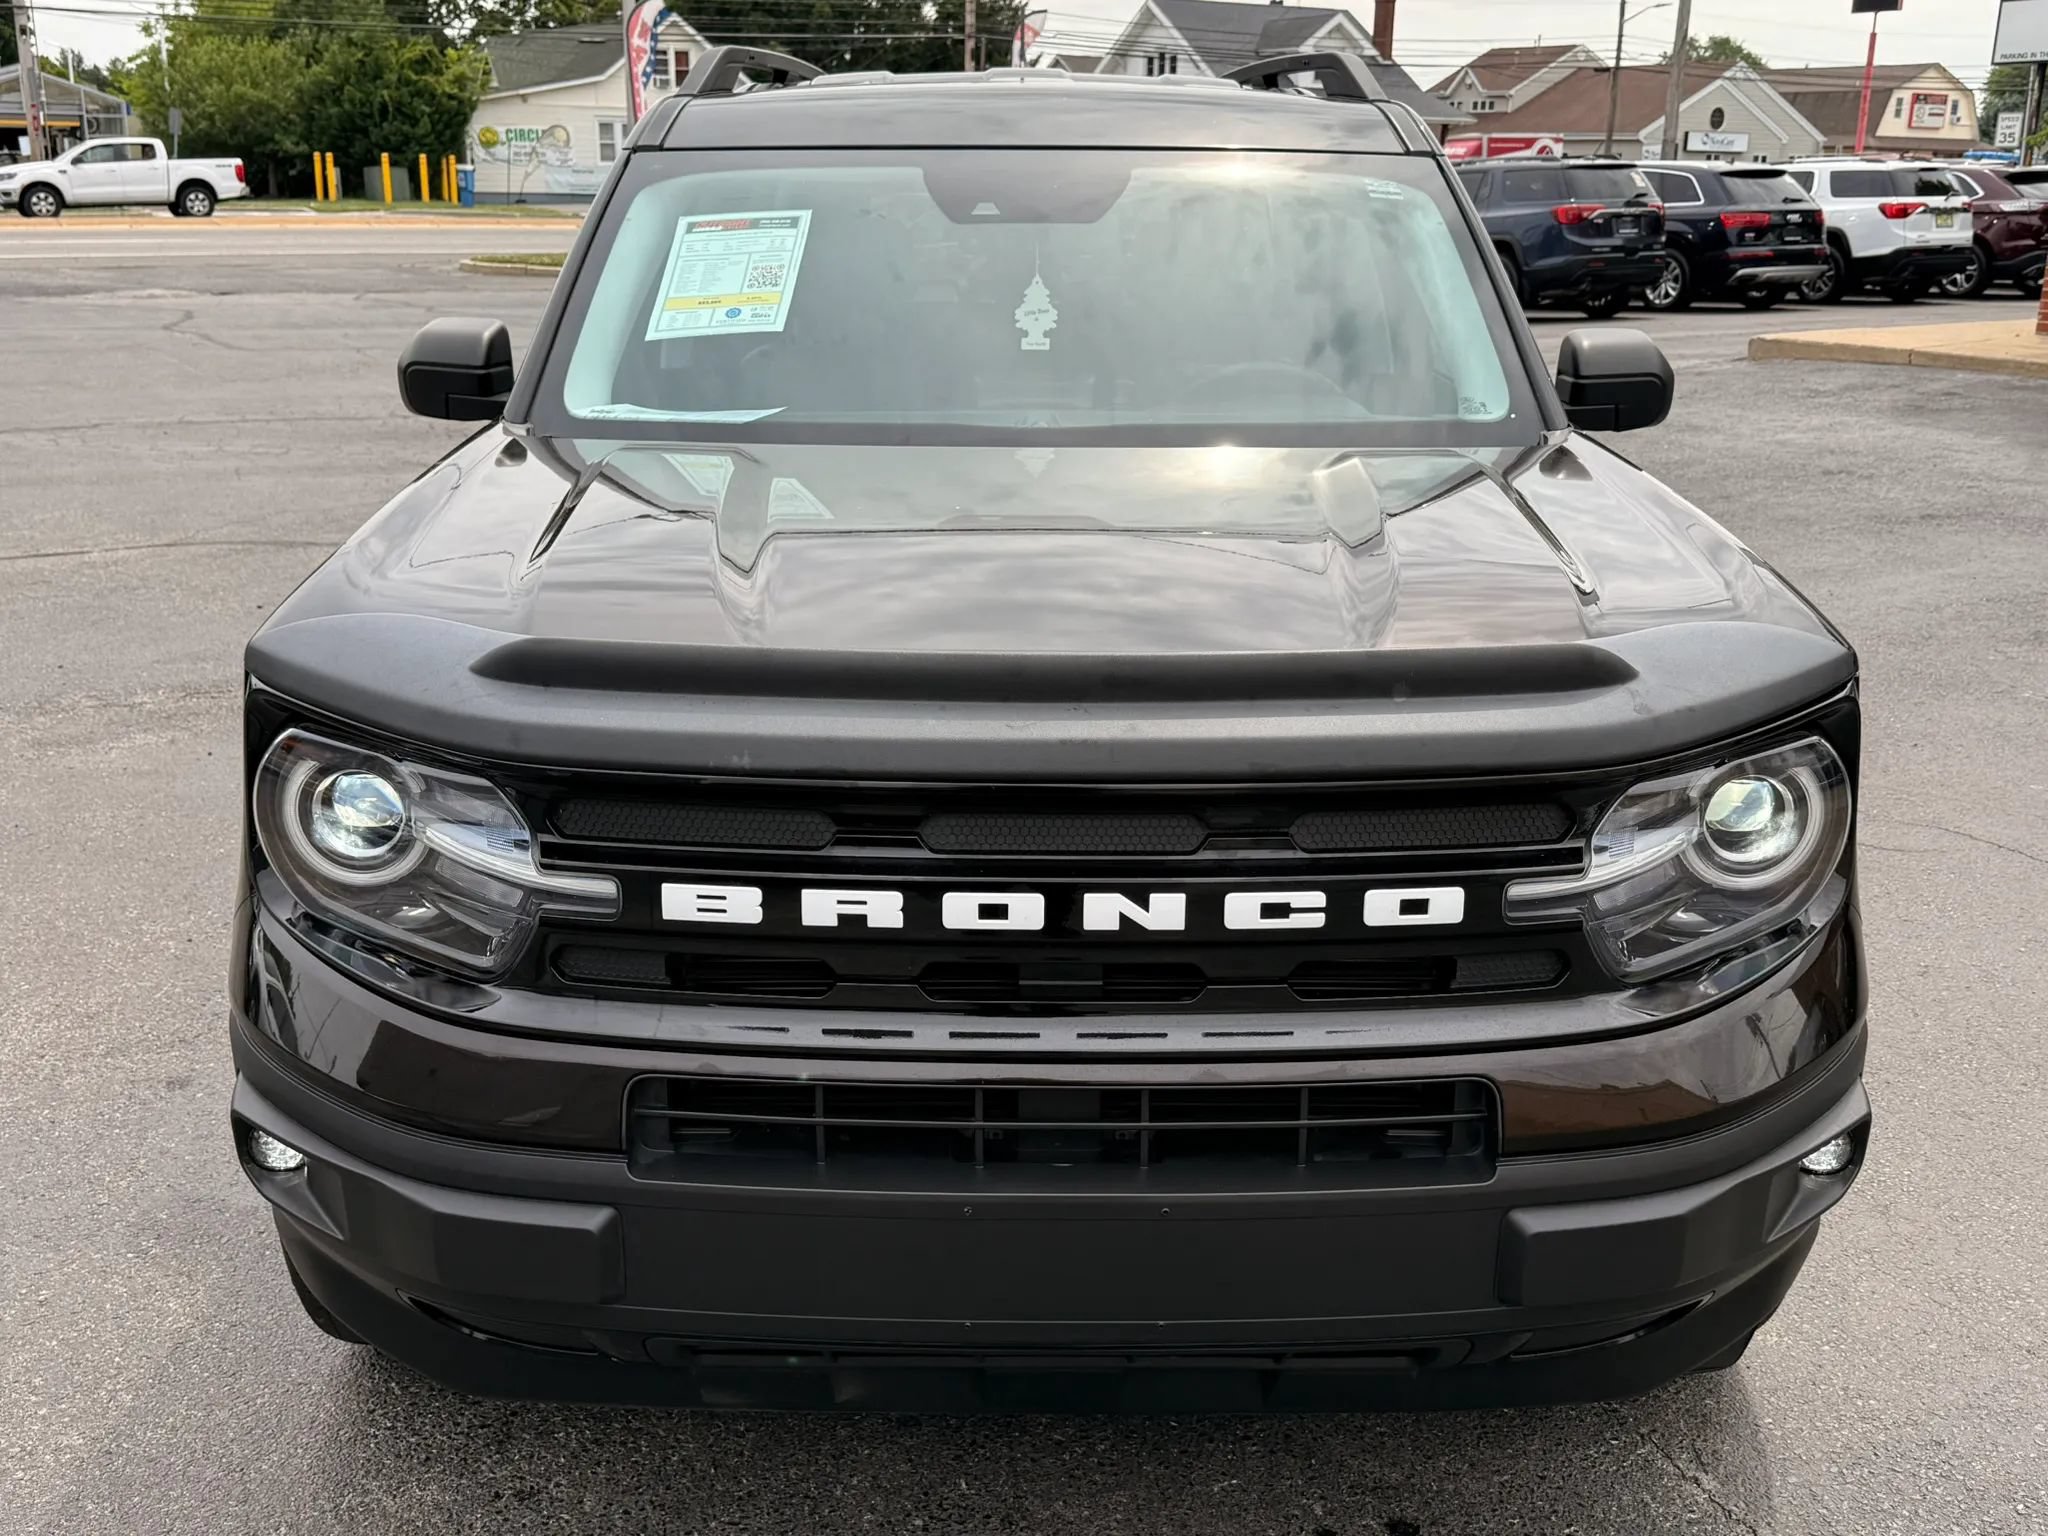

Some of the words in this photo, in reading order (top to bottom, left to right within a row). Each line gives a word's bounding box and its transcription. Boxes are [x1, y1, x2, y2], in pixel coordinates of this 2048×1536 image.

[505, 128, 544, 142] CIRCL
[1999, 132, 2015, 143] 35
[661, 882, 1465, 931] BRONCO
